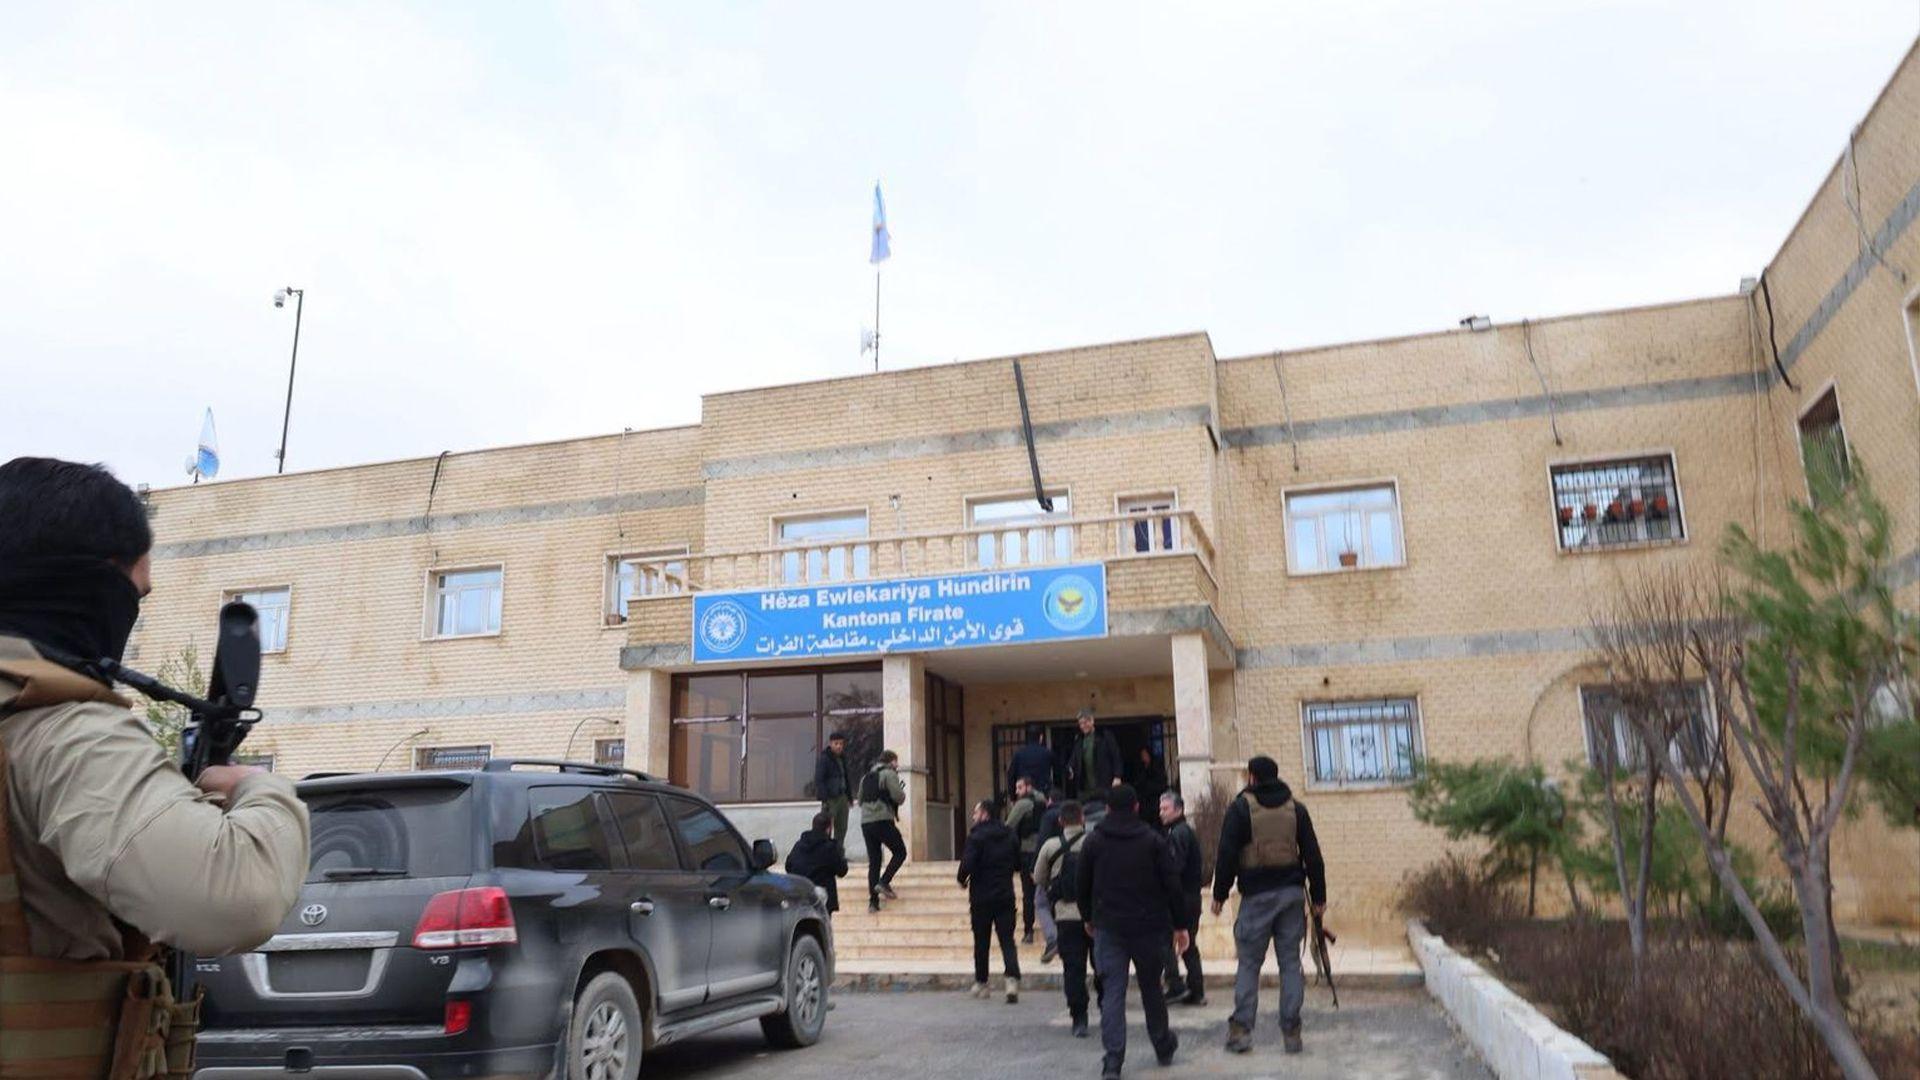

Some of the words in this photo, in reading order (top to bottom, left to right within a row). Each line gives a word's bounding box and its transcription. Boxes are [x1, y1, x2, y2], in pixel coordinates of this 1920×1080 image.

[761, 592, 810, 610] Hêza
[816, 583, 931, 607] Ewlekariya
[823, 611, 901, 629] Kantona
[756, 634, 804, 656] الفرات
[807, 631, 868, 653] مقاطعة
[430, 955, 450, 965] V8
